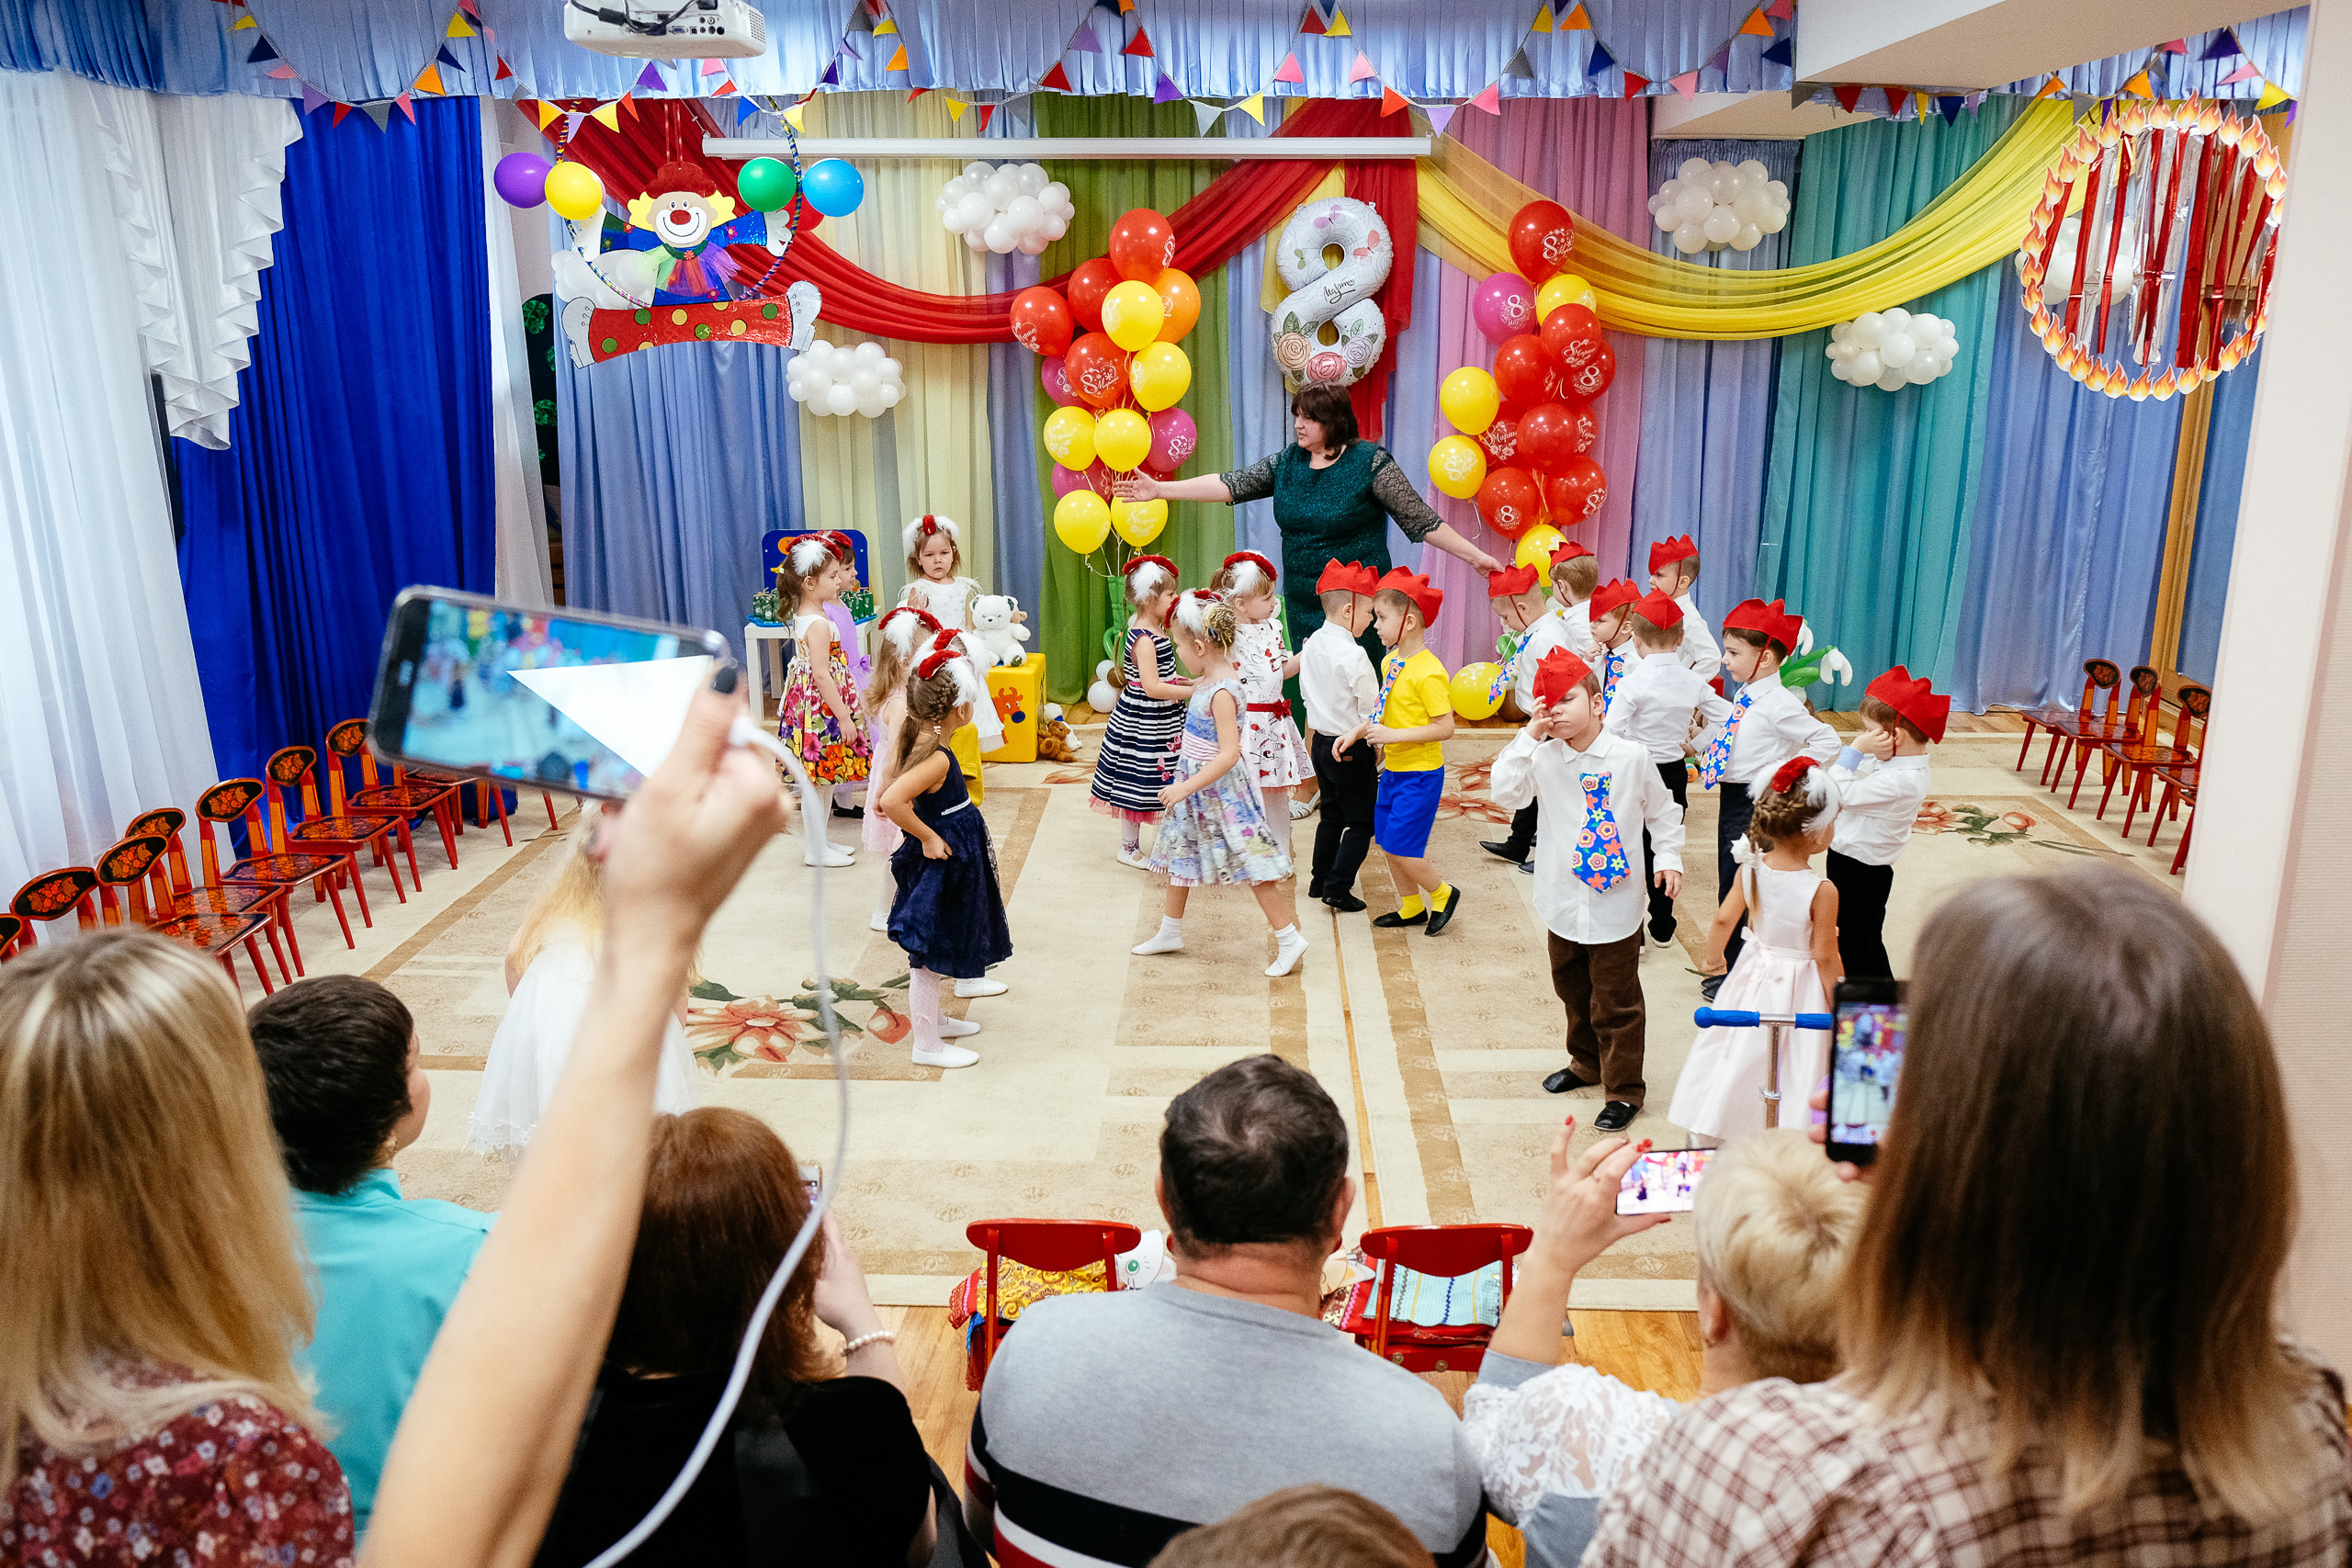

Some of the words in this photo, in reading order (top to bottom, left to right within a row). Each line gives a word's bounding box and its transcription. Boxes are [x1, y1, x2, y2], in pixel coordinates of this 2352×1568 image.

[1162, 240, 1174, 266] 8
[1543, 235, 1557, 259] 8
[1507, 294, 1524, 318] 8
[1564, 341, 1580, 356] 8
[1056, 367, 1066, 386] 8
[1081, 374, 1098, 395] 8
[1580, 366, 1600, 387] 8
[1168, 438, 1182, 456] 8
[1444, 461, 1462, 481] 8
[1500, 505, 1514, 522] 8
[1583, 494, 1600, 514] 8
